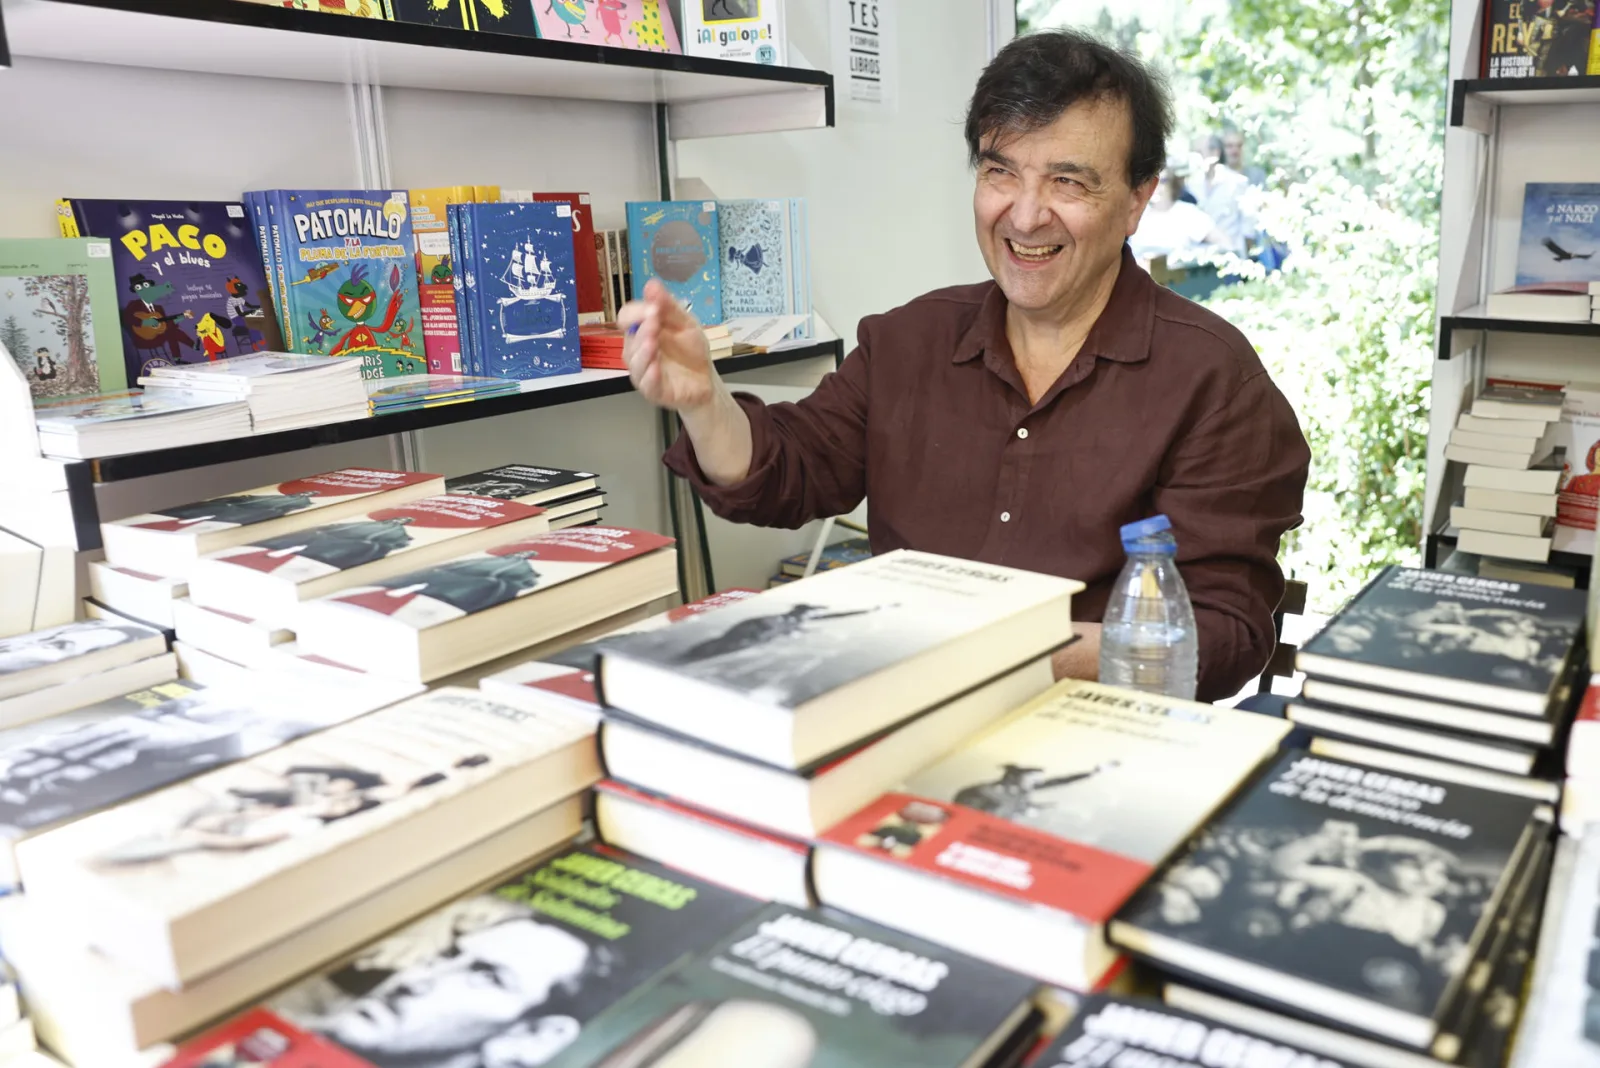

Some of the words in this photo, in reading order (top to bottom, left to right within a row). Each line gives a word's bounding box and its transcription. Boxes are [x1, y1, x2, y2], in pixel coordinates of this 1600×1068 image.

[849, 1, 878, 28] TES
[1509, 3, 1521, 19] EL
[720, 24, 772, 46] galope!
[1491, 21, 1536, 54] REY
[850, 56, 880, 75] LIBROS
[1490, 57, 1499, 67] LA
[1501, 56, 1533, 66] HISTORIA
[1489, 68, 1499, 78] DE
[1557, 204, 1598, 214] NARCO
[294, 208, 401, 243] PATOMALO
[1564, 214, 1594, 223] NAZI
[120, 223, 227, 261] PACO
[271, 224, 283, 262] PATOMALO
[351, 238, 361, 247] LA
[152, 262, 163, 276] y
[164, 251, 175, 266] el
[179, 251, 211, 268] blues
[735, 289, 757, 297] ALICIA
[730, 306, 774, 314] MARAVILLAS
[1456, 576, 1521, 593] CERCAS
